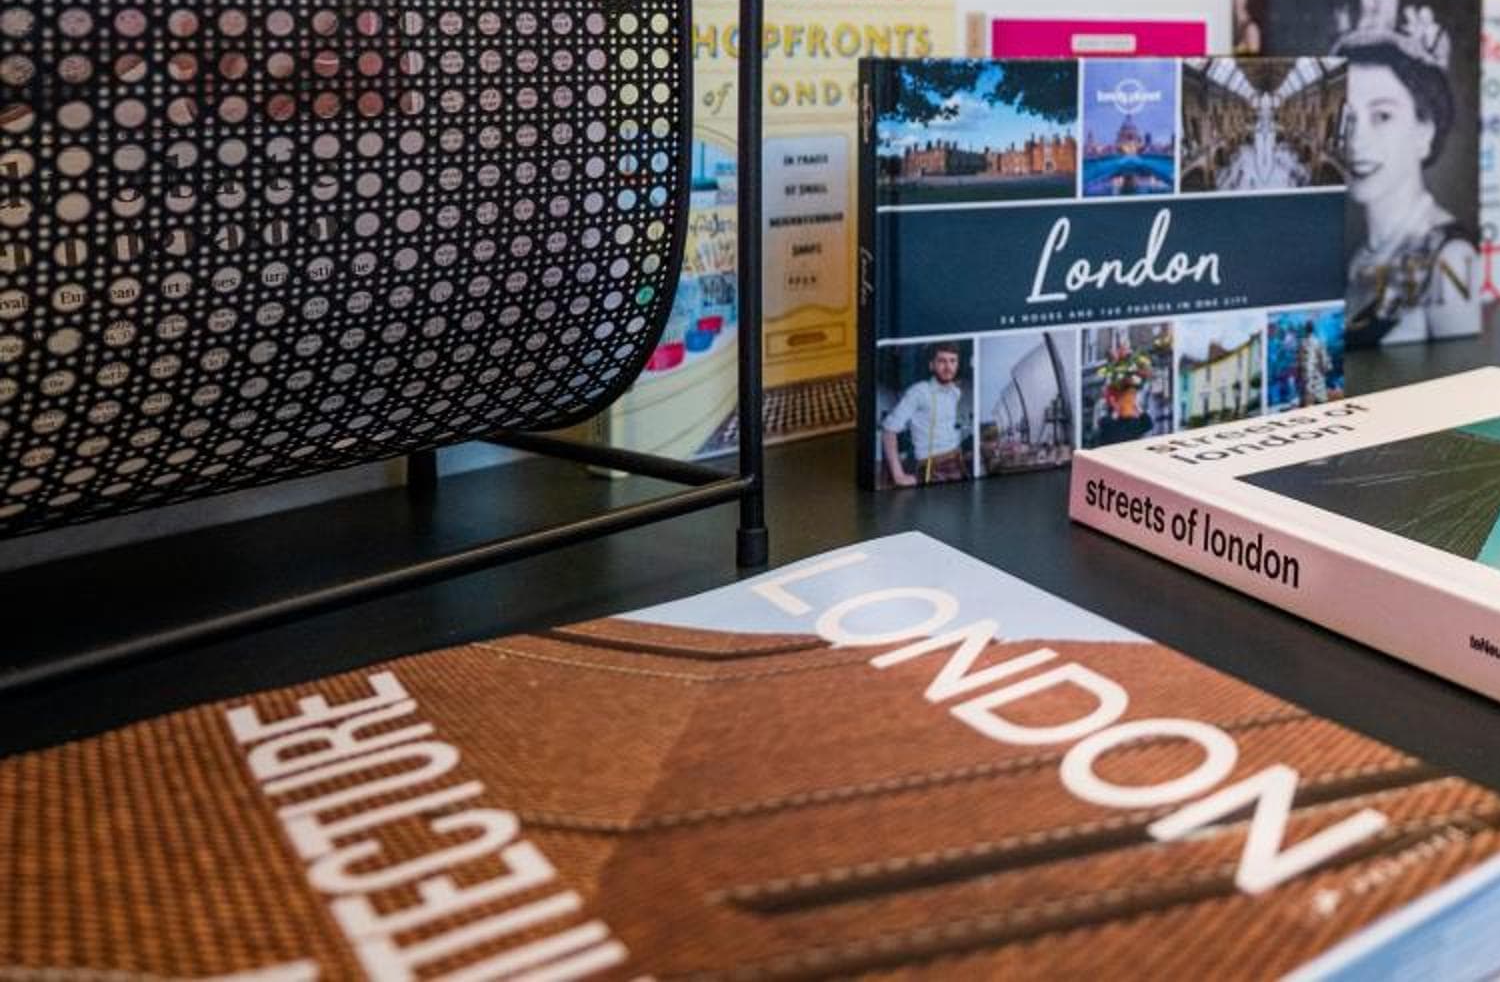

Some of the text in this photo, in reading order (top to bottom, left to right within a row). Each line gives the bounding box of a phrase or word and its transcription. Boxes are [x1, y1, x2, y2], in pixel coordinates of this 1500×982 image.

[692, 22, 932, 59] HOPFRONTS
[702, 77, 858, 115] of OND
[1025, 207, 1221, 304] London
[1324, 401, 1370, 418] of
[1170, 422, 1355, 465] london
[1085, 478, 1300, 589] streets of london
[751, 551, 1390, 896] LONDON
